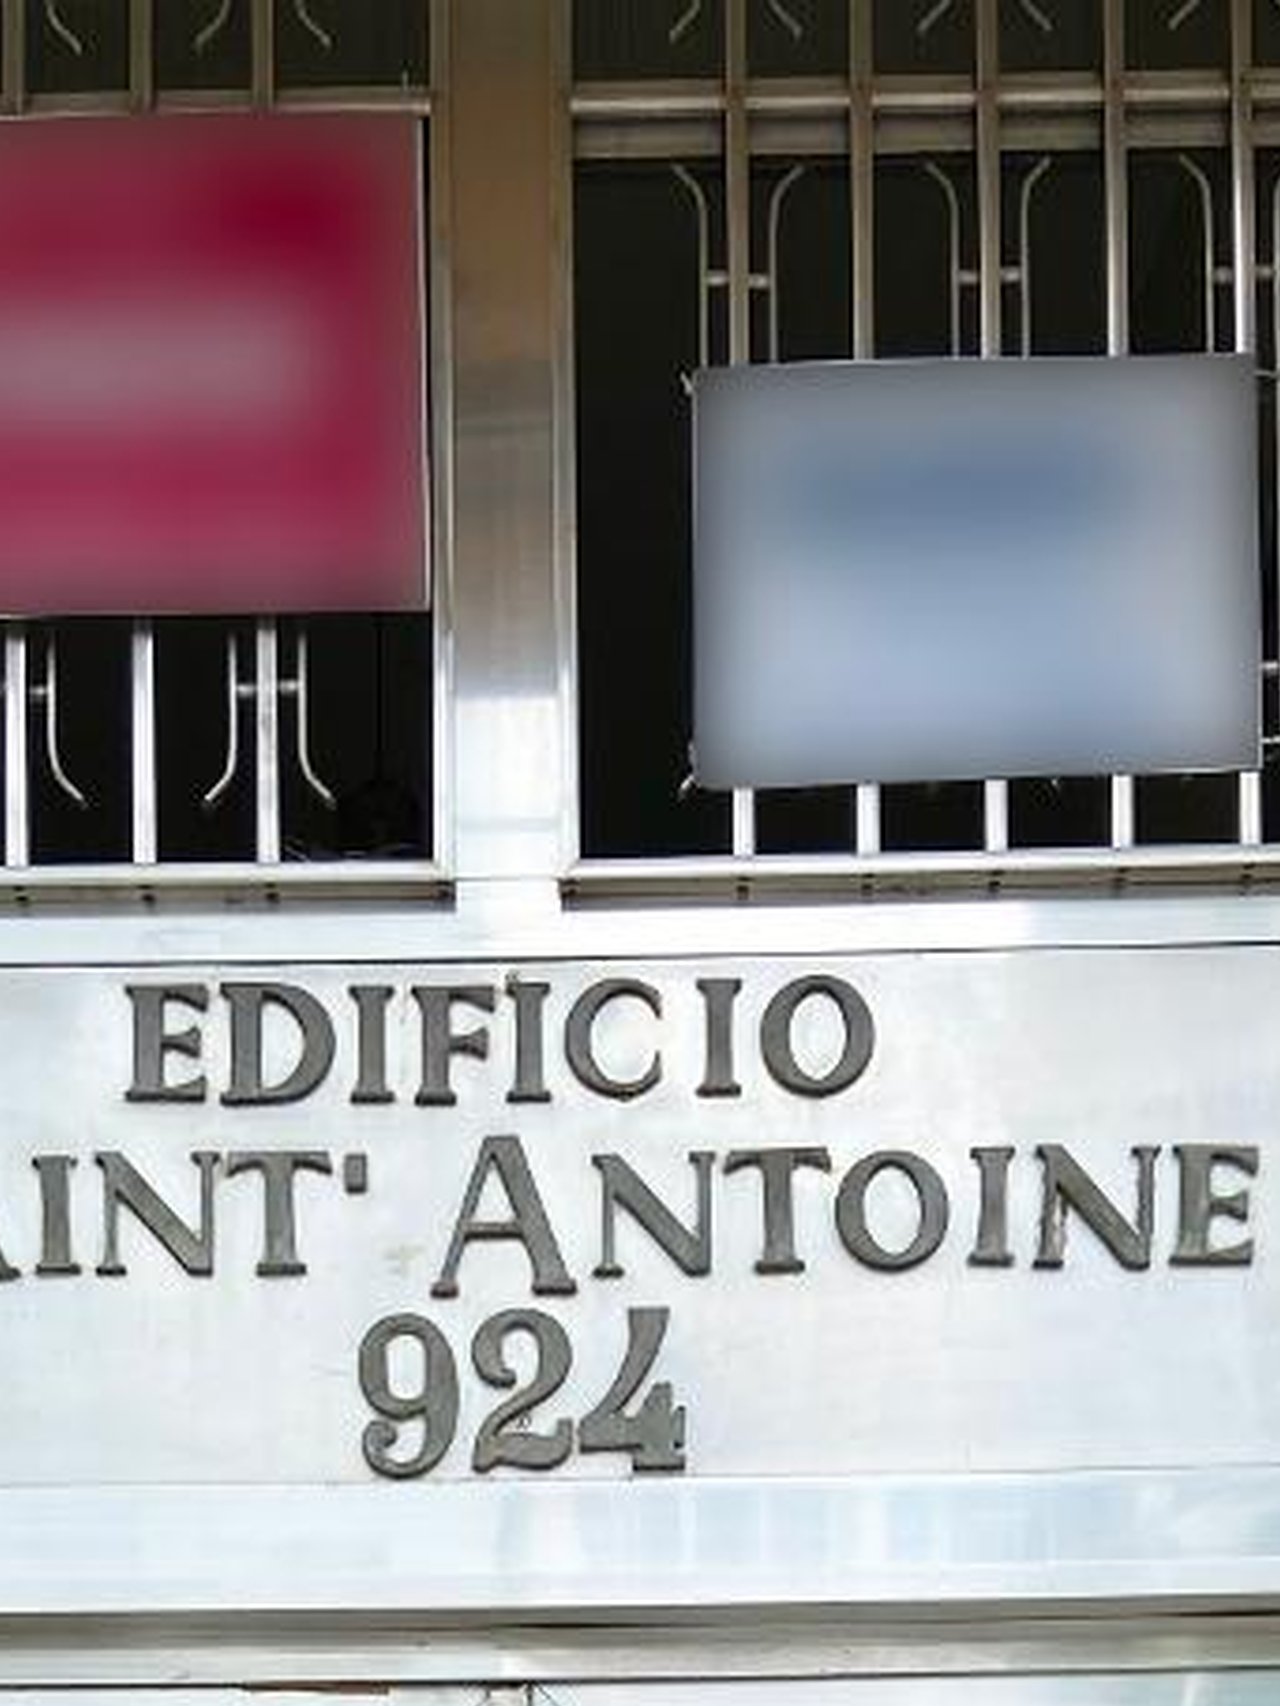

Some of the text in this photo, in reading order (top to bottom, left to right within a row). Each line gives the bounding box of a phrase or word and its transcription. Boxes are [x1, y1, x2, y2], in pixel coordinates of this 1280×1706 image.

[124, 969, 875, 1108] EDIFICIO
[431, 1134, 1260, 1298] ANTOINE
[356, 1308, 688, 1478] 924
